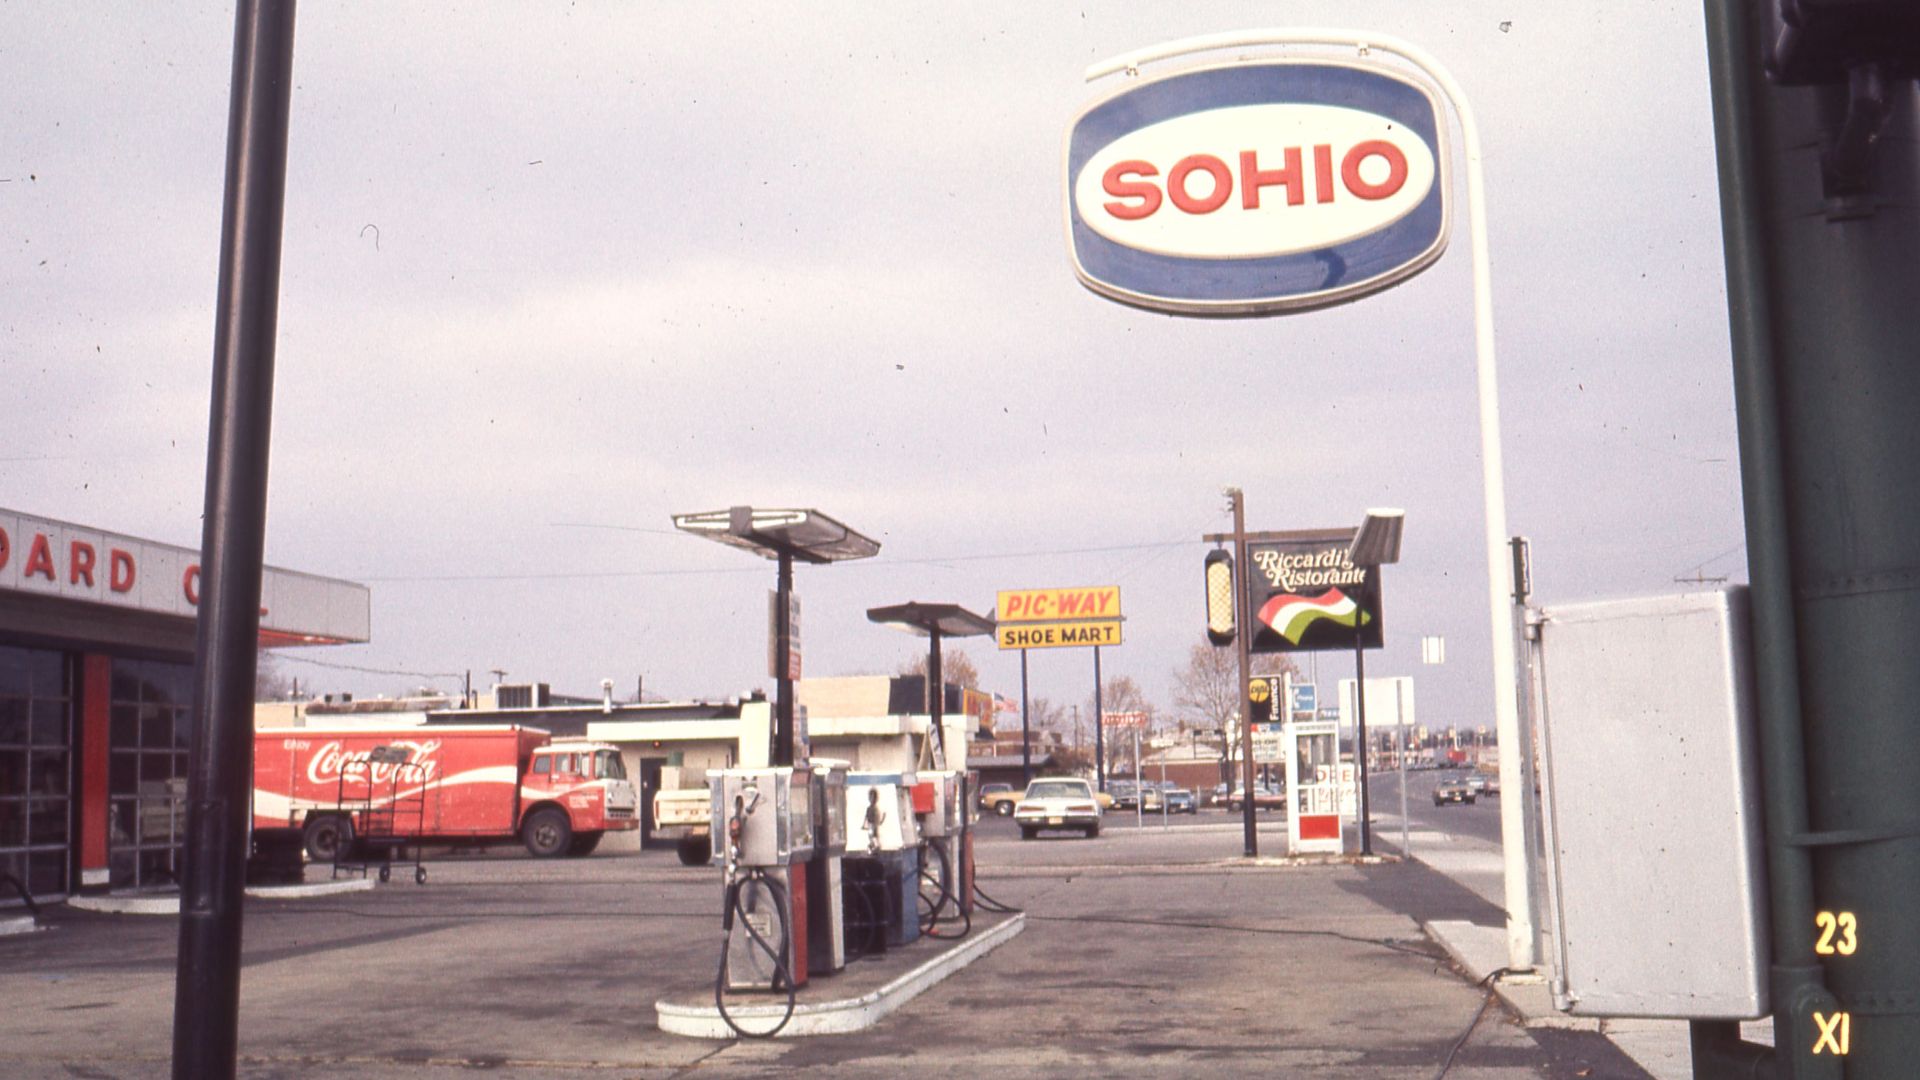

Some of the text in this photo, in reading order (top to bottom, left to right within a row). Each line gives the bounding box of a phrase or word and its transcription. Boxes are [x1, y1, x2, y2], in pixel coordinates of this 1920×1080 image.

[1102, 139, 1409, 221] SOHIO
[1006, 591, 1114, 617] PIC-WAY
[1005, 626, 1114, 645] SHOE MART
